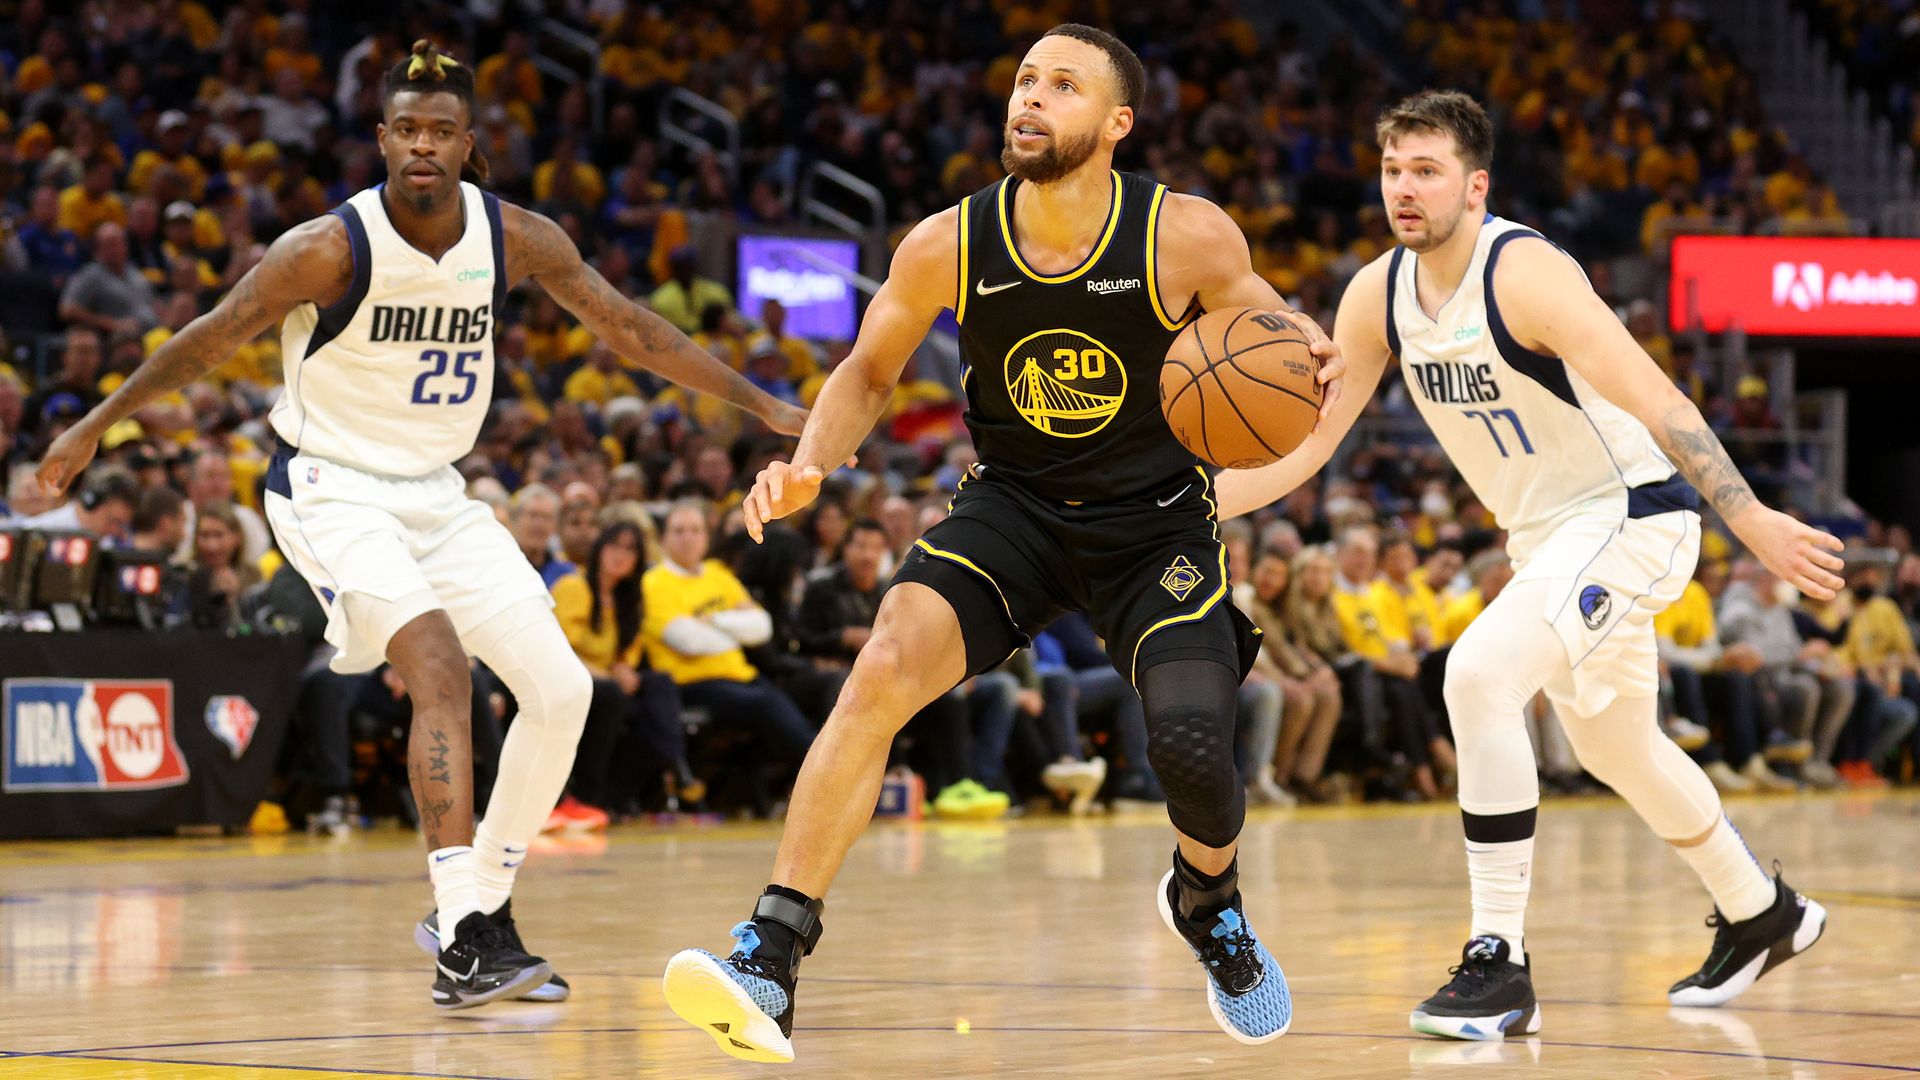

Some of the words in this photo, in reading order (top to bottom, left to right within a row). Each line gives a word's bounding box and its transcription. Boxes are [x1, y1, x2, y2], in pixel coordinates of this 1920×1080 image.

[457, 267, 490, 282] chime
[1086, 278, 1141, 293] Rakuten
[1827, 270, 1919, 305] Adobe
[369, 305, 489, 343] DALLAS
[1455, 326, 1481, 341] chime
[411, 349, 483, 404] 25
[1053, 348, 1106, 380] 30
[1461, 408, 1536, 458] 77
[16, 702, 76, 767] NBA
[107, 723, 163, 754] TNT
[428, 729, 451, 784] STAY
